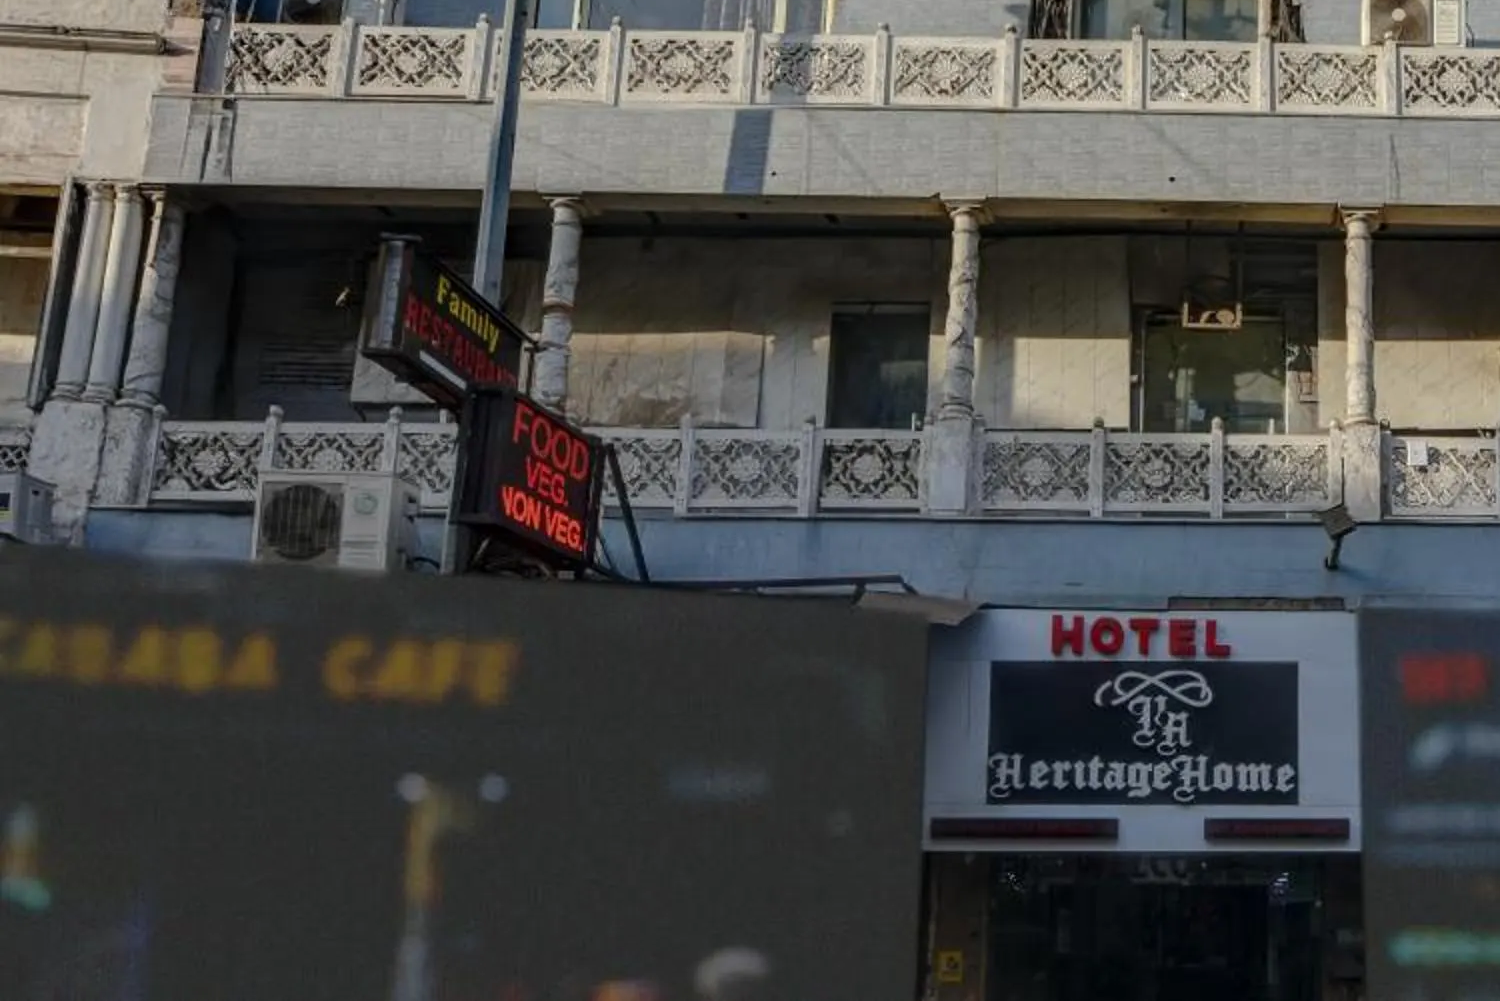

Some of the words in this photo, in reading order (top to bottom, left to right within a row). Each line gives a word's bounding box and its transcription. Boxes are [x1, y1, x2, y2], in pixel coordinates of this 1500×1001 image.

[435, 273, 501, 354] Family
[512, 401, 590, 480] FOOD
[1051, 614, 1231, 659] HOTEL
